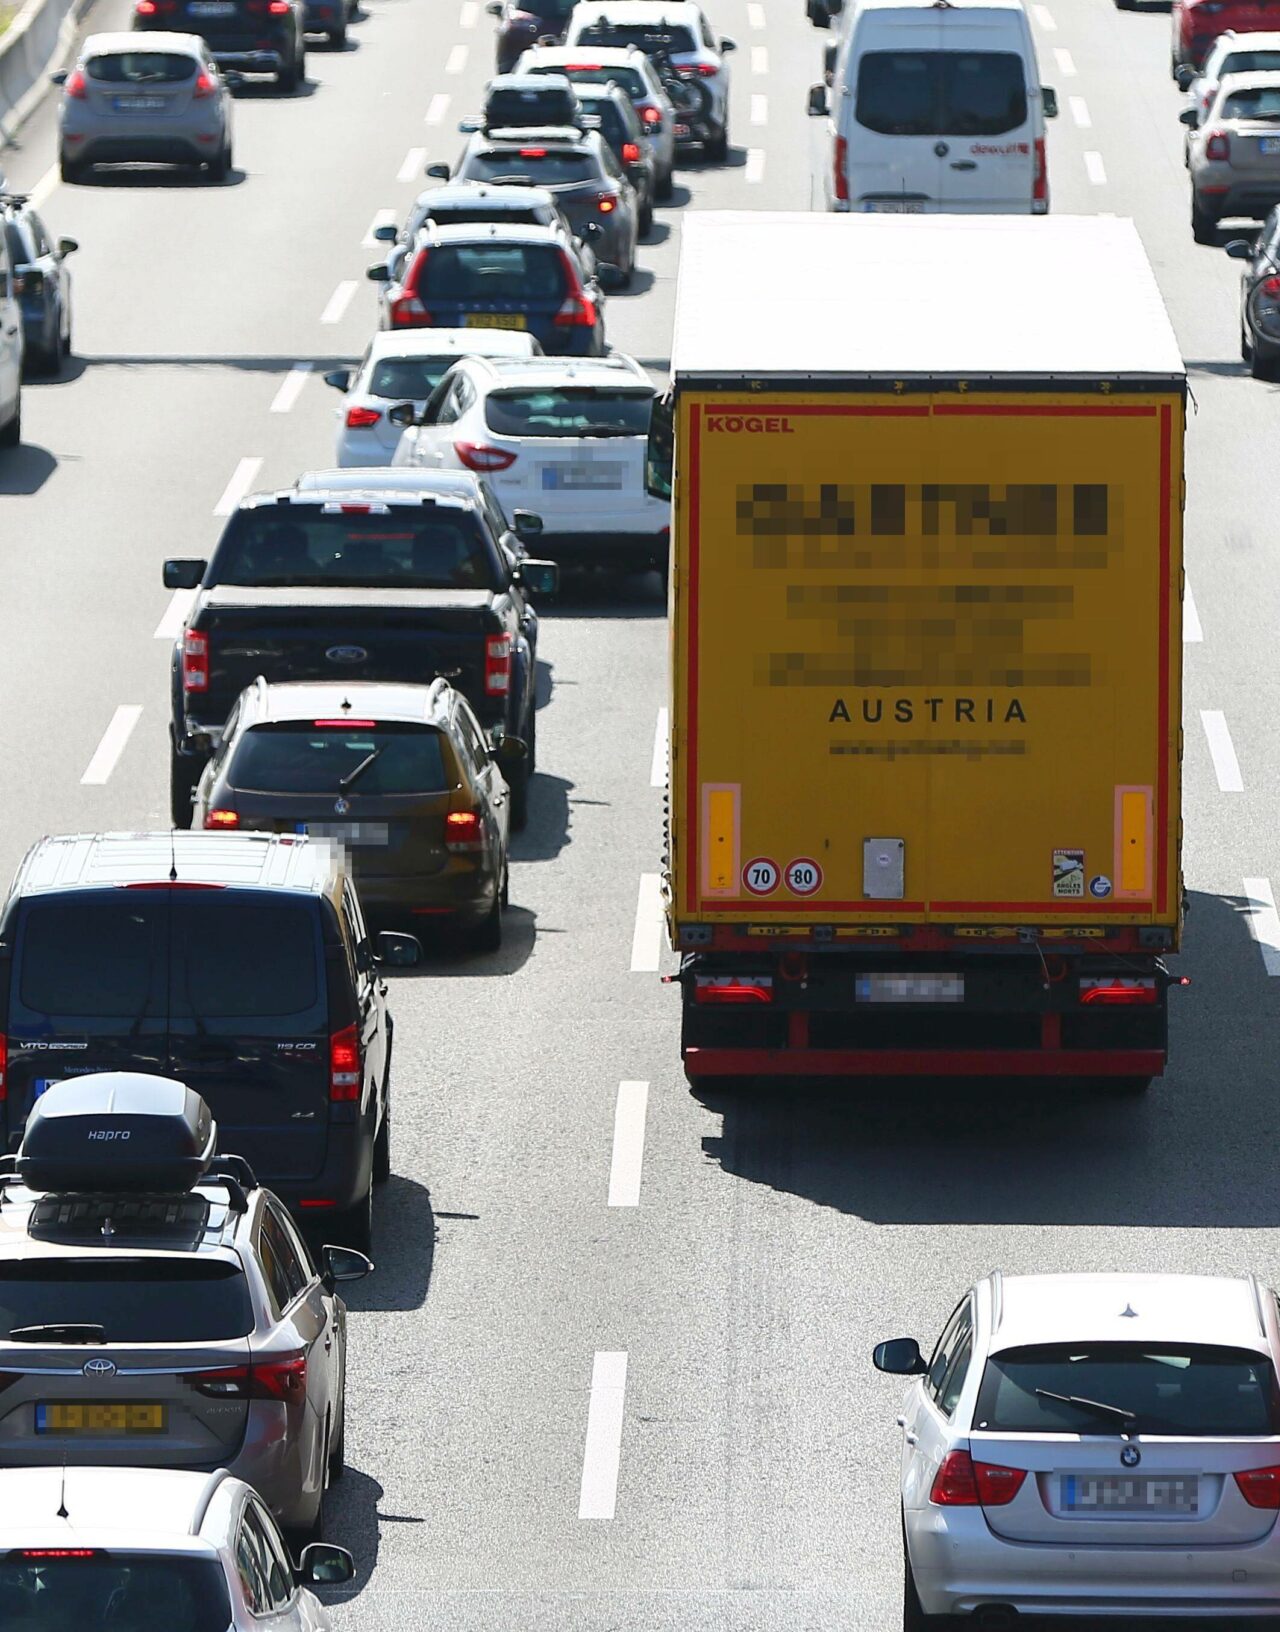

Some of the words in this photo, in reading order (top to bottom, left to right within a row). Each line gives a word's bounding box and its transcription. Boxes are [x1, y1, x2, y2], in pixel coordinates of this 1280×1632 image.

[707, 416, 795, 433] KÖGEL
[829, 699, 1026, 722] AUSTRIA
[753, 869, 771, 885] 70
[794, 869, 812, 885] 80
[20, 1042, 48, 1050] VITO
